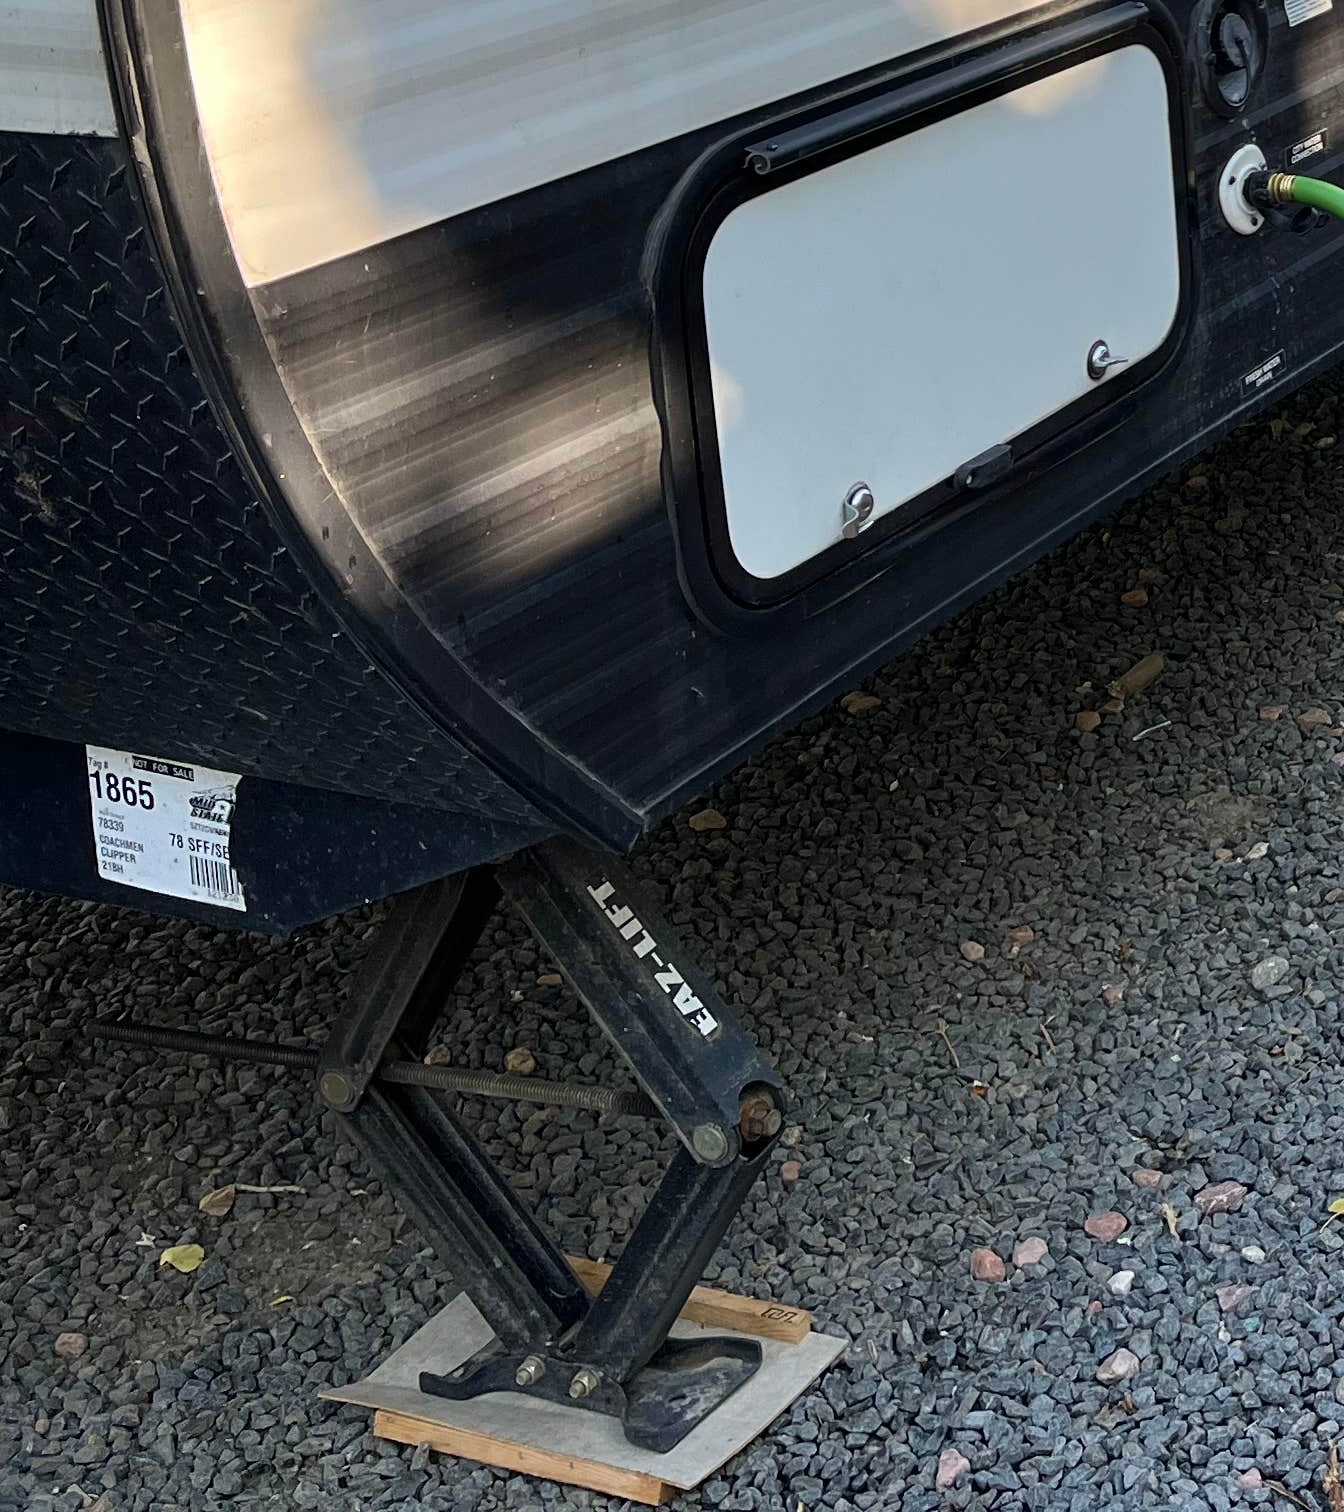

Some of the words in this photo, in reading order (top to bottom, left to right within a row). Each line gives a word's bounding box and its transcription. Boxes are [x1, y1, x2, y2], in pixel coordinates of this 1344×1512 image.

[88, 756, 102, 770] Tag
[152, 762, 169, 774] FOR
[173, 767, 194, 780] SALE
[89, 770, 155, 810] 1865
[98, 816, 124, 832] 78339
[99, 834, 144, 853] COACHMEN
[169, 832, 184, 849] 78
[100, 846, 137, 864] CLIPPER
[586, 879, 720, 1037] EAZ-LIFT
